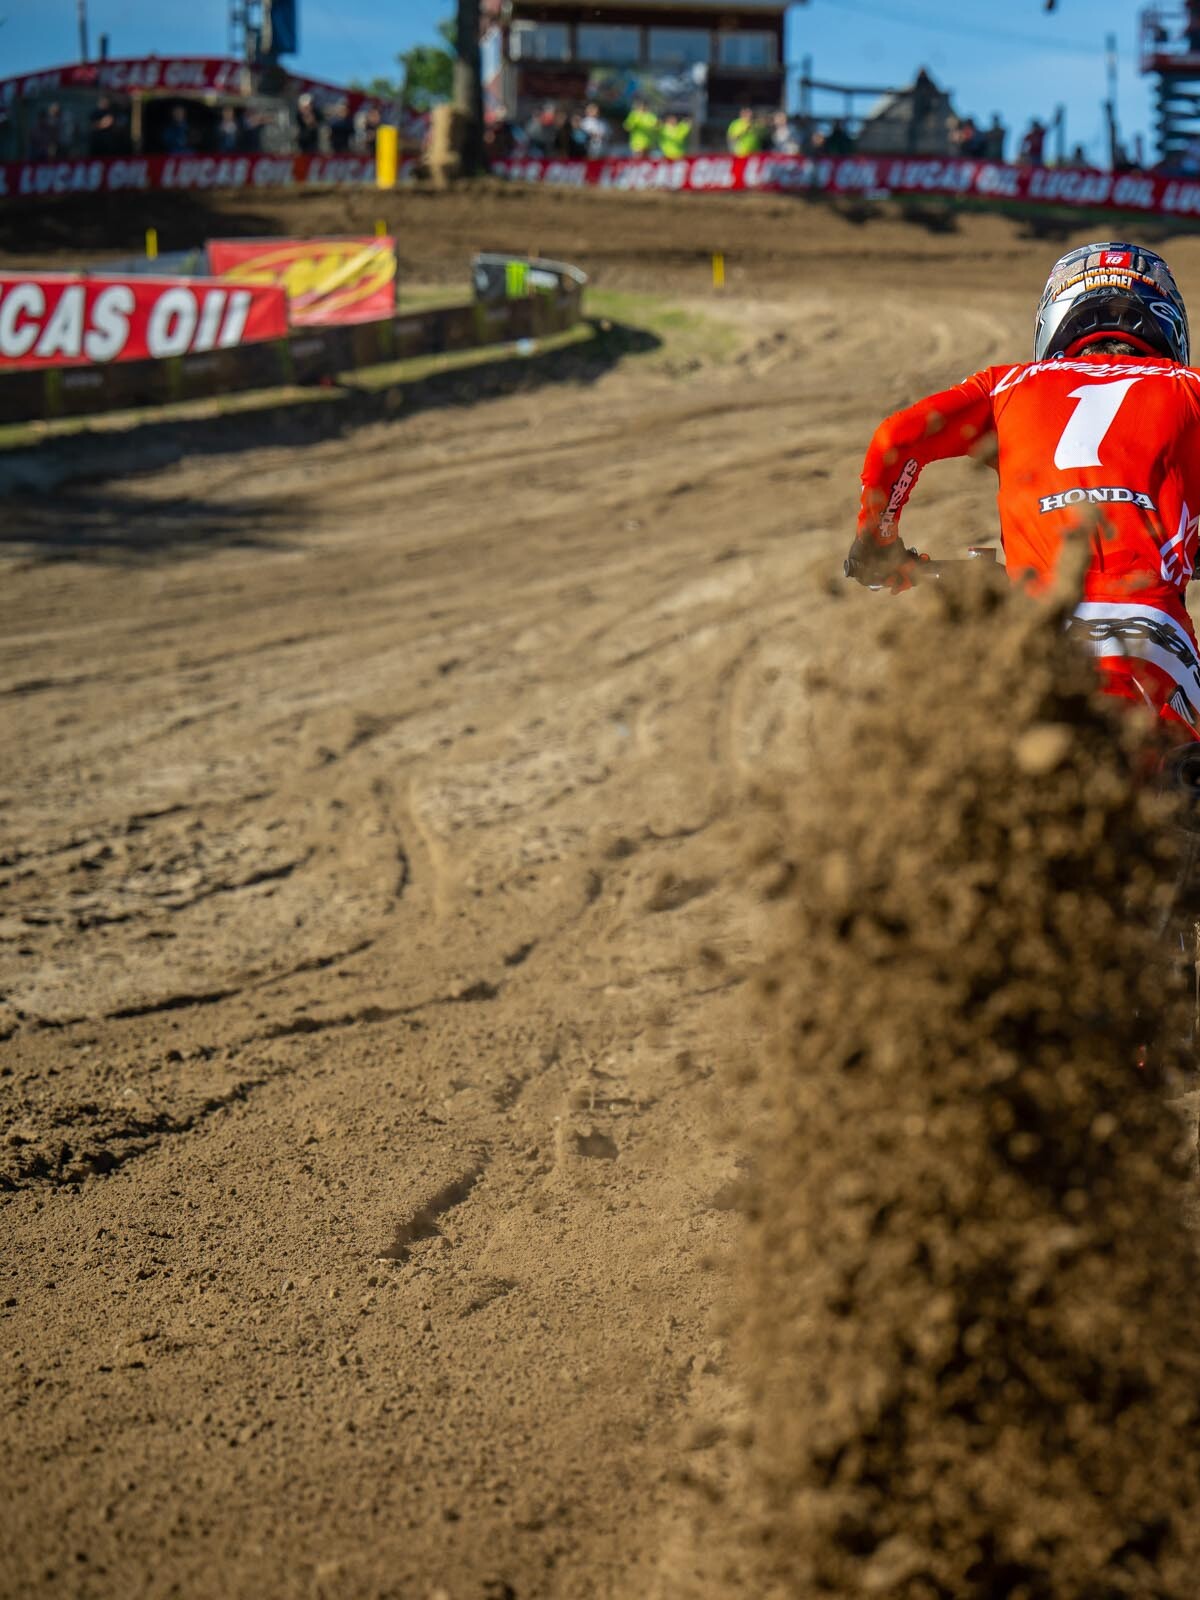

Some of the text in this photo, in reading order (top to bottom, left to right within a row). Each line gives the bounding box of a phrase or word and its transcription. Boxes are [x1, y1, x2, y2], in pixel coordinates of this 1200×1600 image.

[20, 160, 101, 194] LUCAS
[107, 158, 150, 189] OIL
[162, 157, 249, 188] LUCAS
[253, 156, 297, 186] OIL
[690, 157, 736, 188] OIL
[888, 161, 974, 193] LUCAS
[976, 163, 1020, 196] OIL
[1028, 167, 1112, 202] LUCAS
[1112, 175, 1156, 208] OIL
[1054, 378, 1144, 471] 1
[1039, 487, 1157, 513] HONDA
